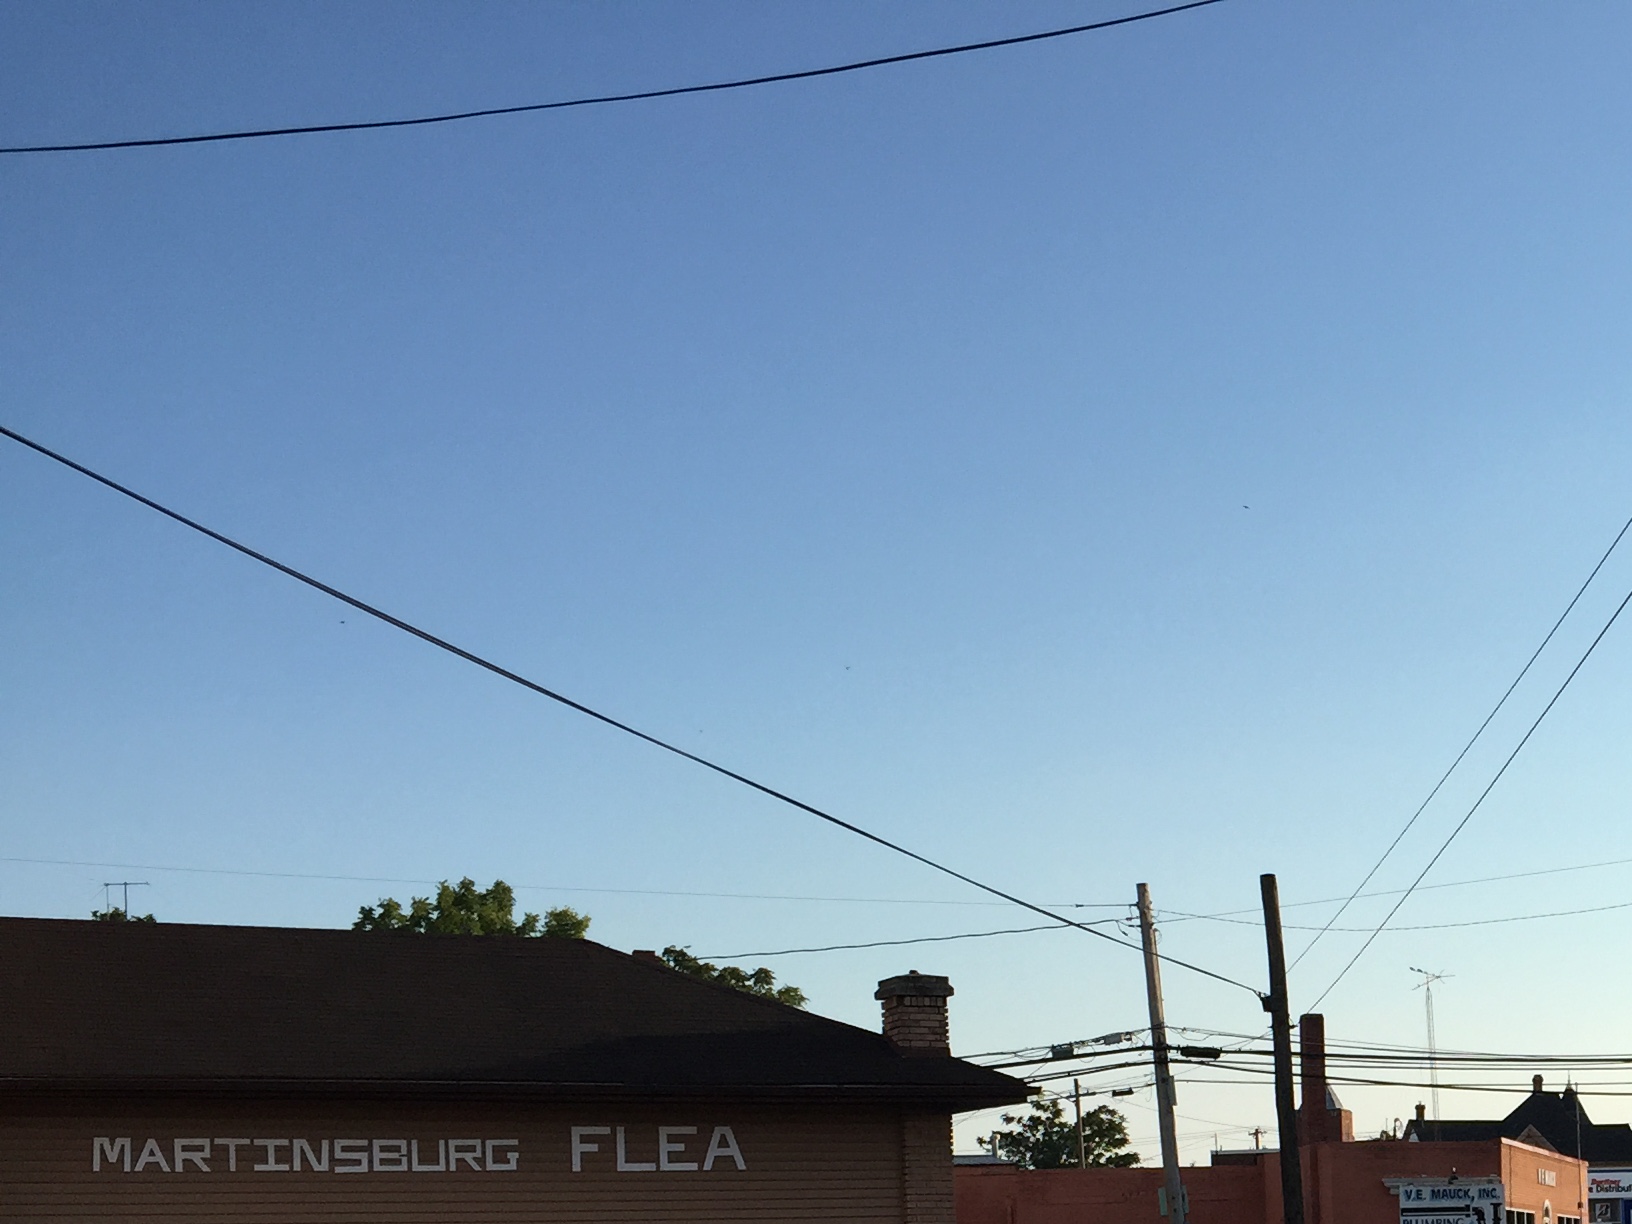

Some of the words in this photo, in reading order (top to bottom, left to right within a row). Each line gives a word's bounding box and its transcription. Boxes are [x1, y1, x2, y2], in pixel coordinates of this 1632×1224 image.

[92, 1136, 520, 1174] MARTINSBURG
[570, 1125, 747, 1173] FLEA
[1404, 1189, 1426, 1201] V.E.
[1431, 1189, 1475, 1203] MAUCK,
[1478, 1187, 1500, 1200] INC.
